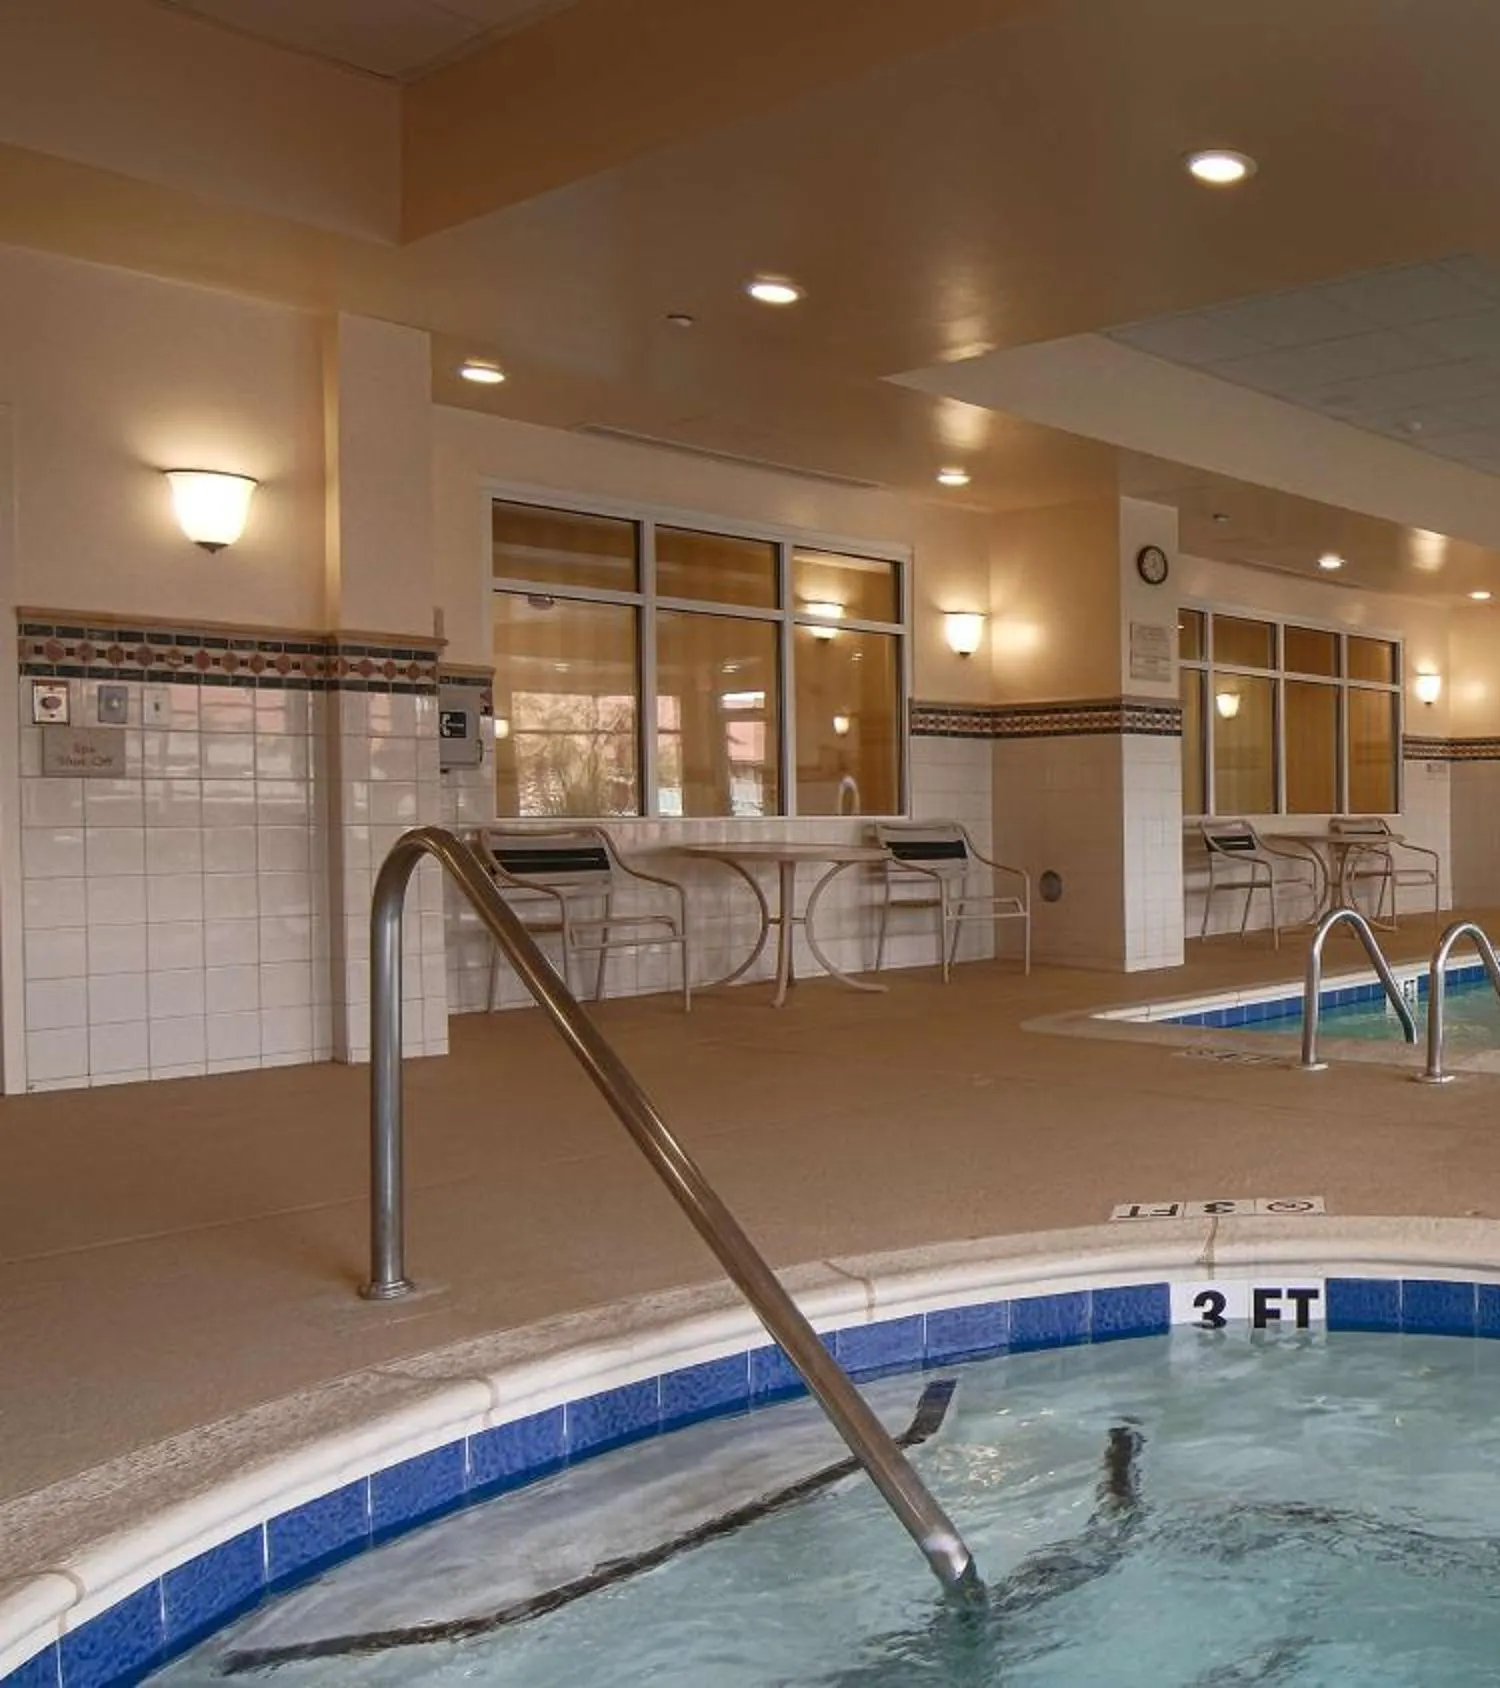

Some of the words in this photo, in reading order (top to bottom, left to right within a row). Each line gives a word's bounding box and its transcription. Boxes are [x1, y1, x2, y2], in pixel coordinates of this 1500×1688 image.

[1117, 1203, 1178, 1218] FT
[1203, 1201, 1236, 1213] 3
[1193, 1289, 1228, 1329] 3
[1253, 1288, 1319, 1329] FT
